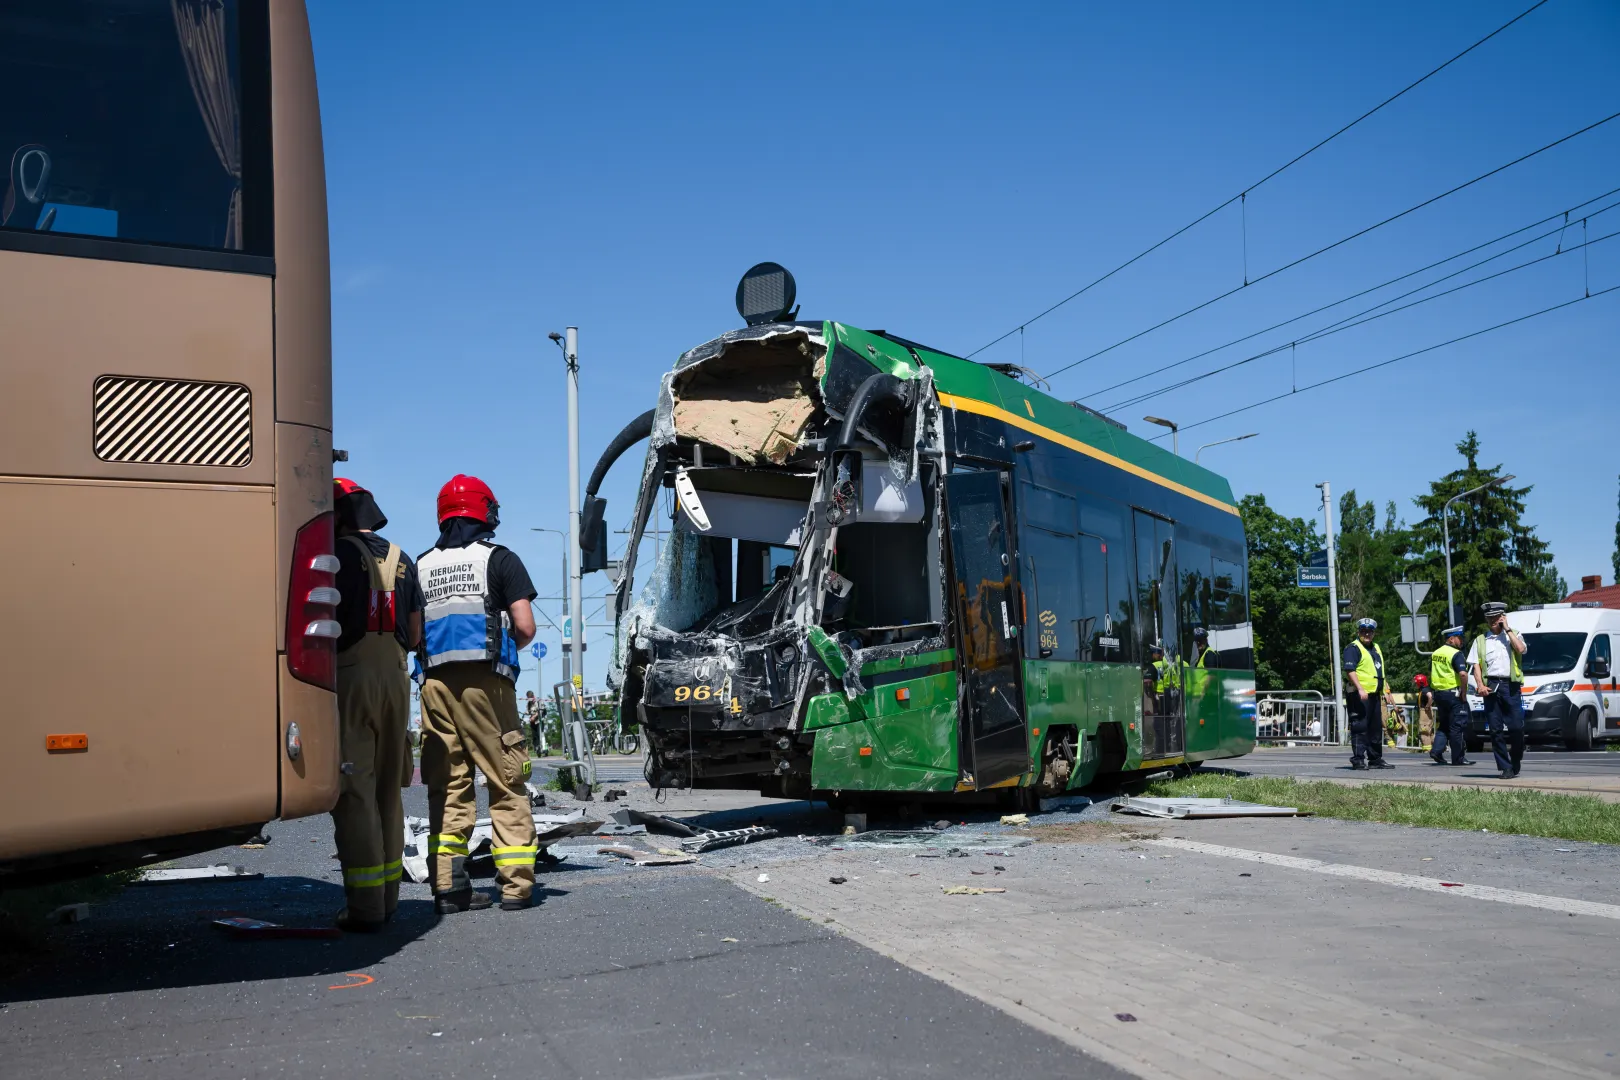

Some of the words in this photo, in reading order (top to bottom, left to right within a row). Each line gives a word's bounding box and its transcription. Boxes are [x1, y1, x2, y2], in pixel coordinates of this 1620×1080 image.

[428, 573, 475, 588] DZIAŁANIEM
[424, 583, 480, 600] RATOWNICZYM
[1040, 634, 1058, 648] 964
